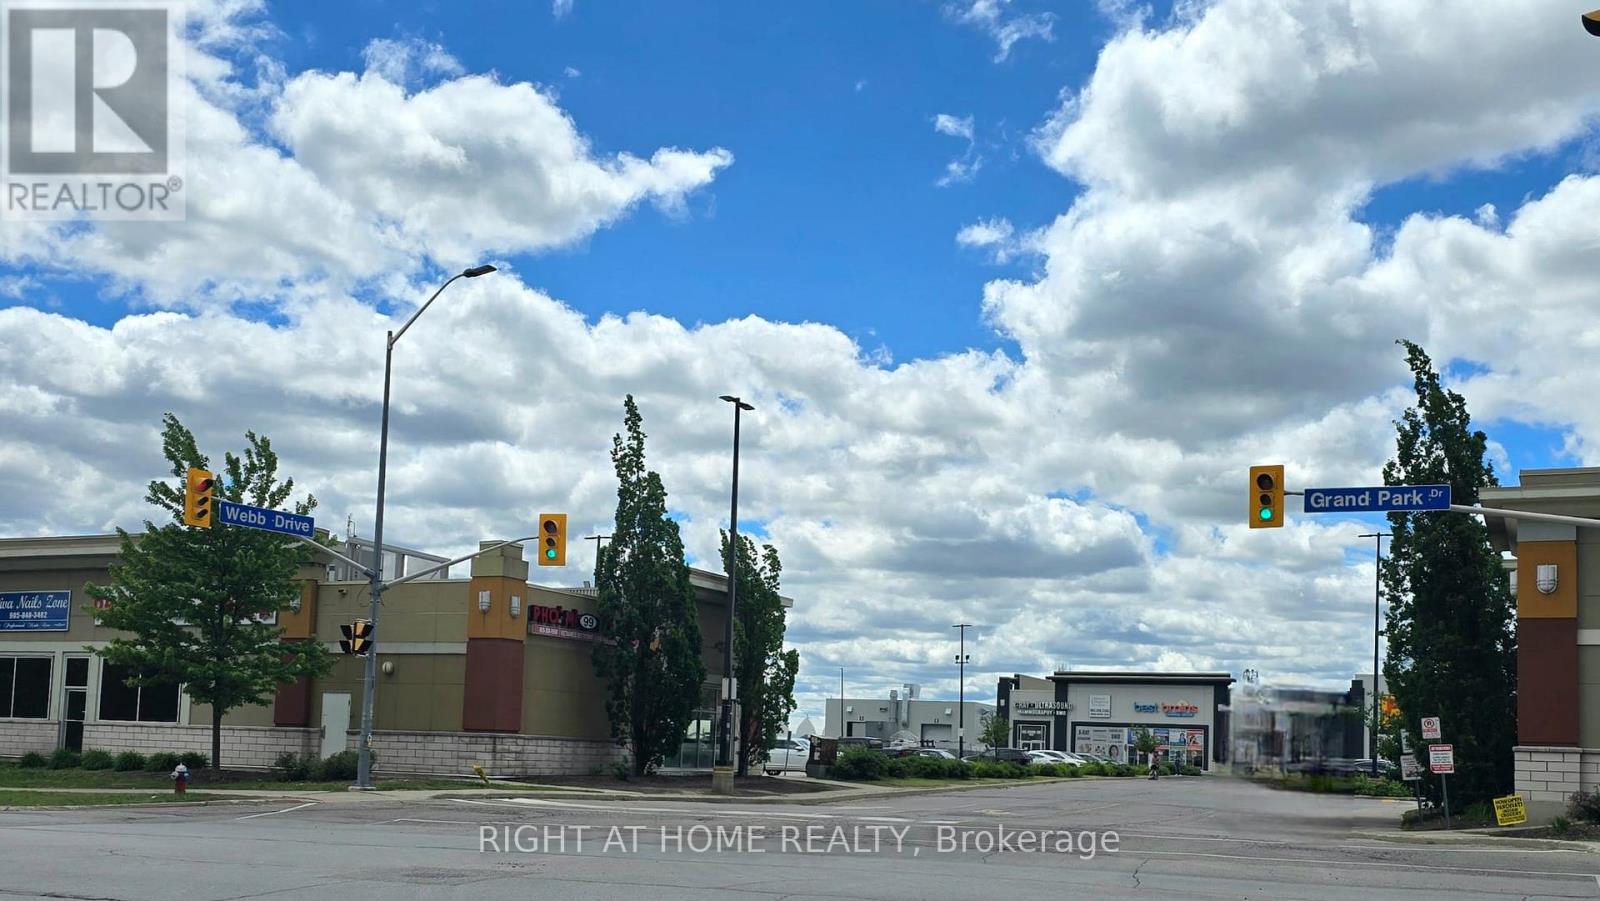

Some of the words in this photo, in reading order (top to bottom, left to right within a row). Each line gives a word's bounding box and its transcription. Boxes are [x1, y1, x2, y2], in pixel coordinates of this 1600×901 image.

[1310, 491, 1370, 508] Grand
[1378, 490, 1424, 506] Park
[1430, 488, 1443, 498] Dr
[225, 506, 266, 525] Webb
[275, 514, 310, 532] Drive
[0, 597, 14, 610] iva
[16, 595, 42, 609] Nails
[45, 594, 68, 609] Zone
